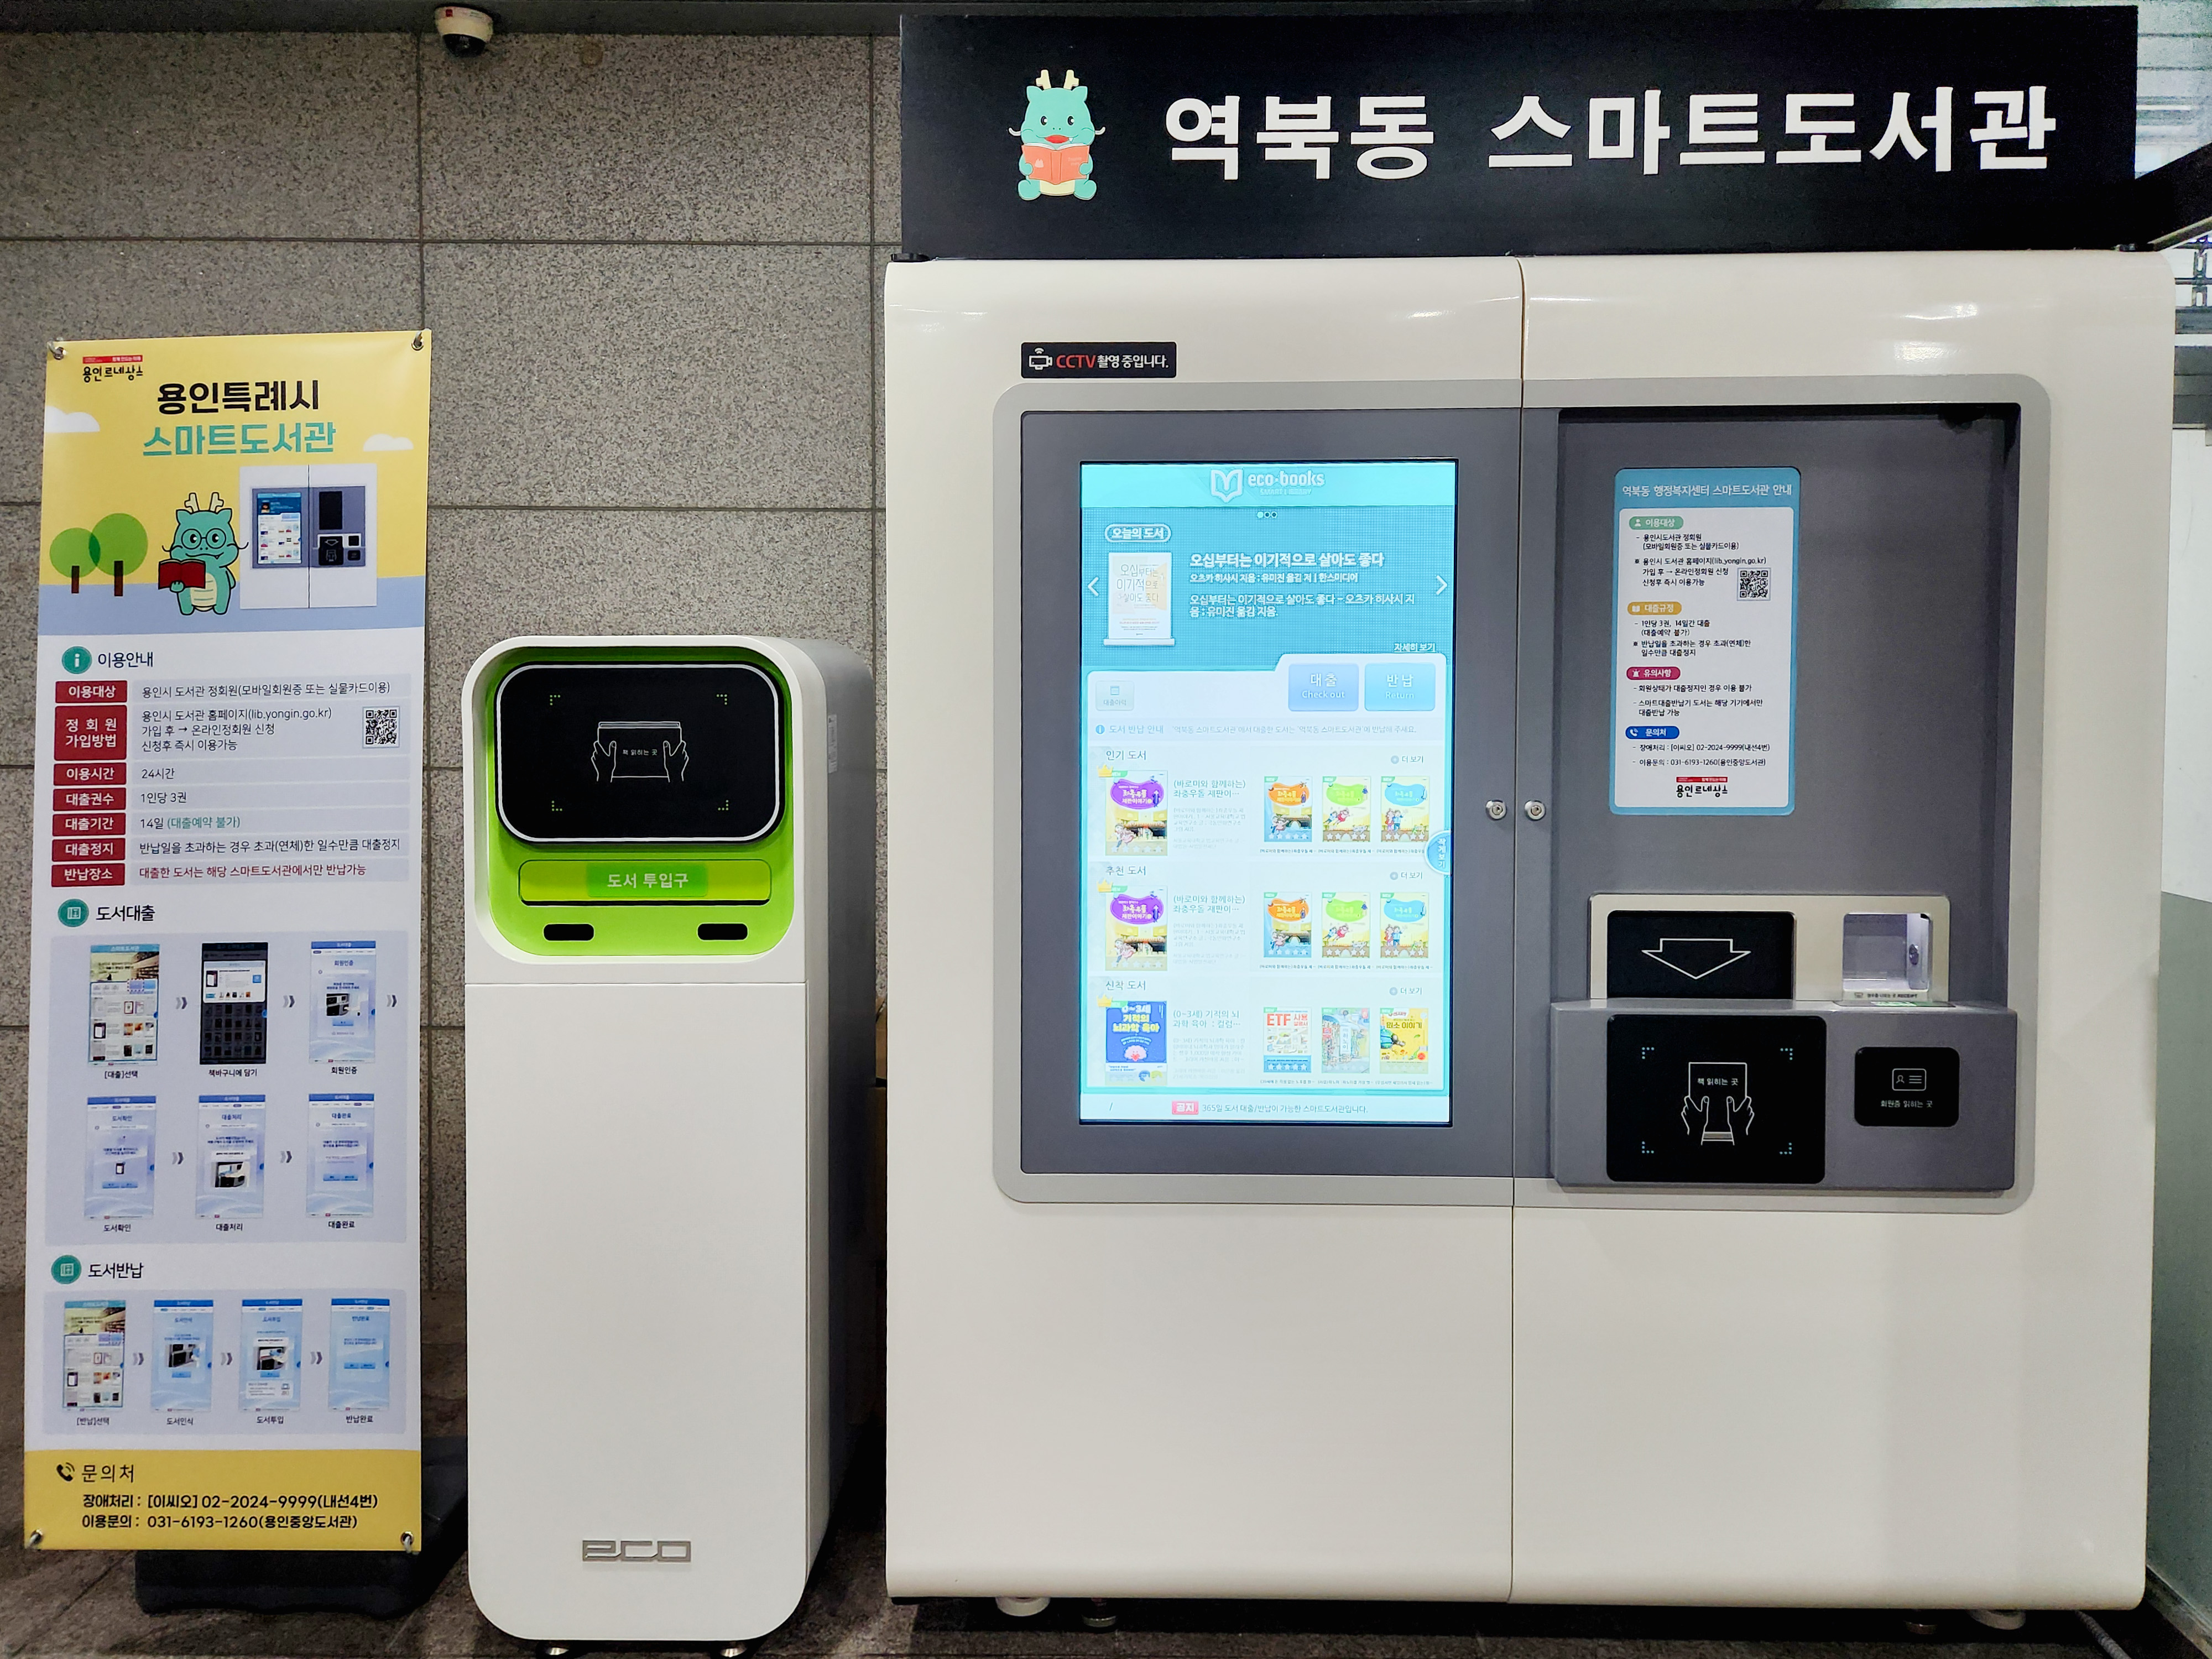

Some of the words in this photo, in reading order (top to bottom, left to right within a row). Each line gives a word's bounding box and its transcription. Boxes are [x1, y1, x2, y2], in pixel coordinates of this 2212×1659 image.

[1166, 96, 1433, 180] 역북동
[1489, 86, 2056, 175] 스마트도서관
[158, 380, 318, 414] 용인특례시
[143, 422, 336, 456] 스마트도서관
[1622, 486, 1650, 497] 역북동
[1654, 485, 1709, 497] 행정복지센터
[1713, 484, 1769, 497] 스마트도서관
[1773, 484, 1791, 495] 안내
[1645, 518, 1675, 528] 이용대상
[1111, 528, 1141, 539] 오늘의
[1144, 528, 1164, 539] 도서
[1644, 541, 1683, 550] (모바일회원증
[1190, 552, 1252, 568] 오십부터는
[1255, 553, 1316, 567] 이기적으로
[1319, 552, 1356, 567] 살아도
[1359, 552, 1385, 567] 좋다
[1686, 557, 1766, 565] 홈페이지(lib.yongin.go.kr)
[1643, 603, 1673, 613] 대출규정
[1394, 643, 1417, 651] 자세히
[1420, 643, 1436, 651] 보기
[98, 652, 153, 668] 이용안내
[1644, 669, 1671, 677] 유의사항
[69, 685, 116, 698] 이용대상
[142, 687, 171, 698] 용인시
[175, 686, 205, 697] 도서관
[208, 684, 302, 697] 정회원(모바일회원증
[305, 684, 325, 695] 또는
[328, 682, 389, 695] 실물카드이용)
[1302, 690, 1328, 698] Check
[142, 711, 171, 722] 용인시
[175, 710, 205, 721] 도서관
[208, 707, 331, 721] 홈페이지(lib.yongin.go.kr)
[142, 726, 161, 737] 가입
[165, 726, 175, 737] 후
[191, 724, 251, 735] 온라인정회원
[255, 723, 274, 734] 신청
[1109, 726, 1125, 734] 도서
[1129, 725, 1145, 734] 반납
[1147, 725, 1163, 734] 안내
[1646, 728, 1666, 737] 문의처
[66, 734, 116, 748] 가입방법
[142, 740, 171, 752] 신청후
[175, 740, 194, 751] 즉시
[198, 739, 237, 751] 이용가능
[1107, 750, 1124, 760] 인기
[1128, 750, 1146, 760] 도서
[67, 768, 114, 780] 이용시간
[142, 768, 175, 779] 24시간
[66, 792, 114, 806] 대출권수
[141, 792, 167, 804] 1인당
[170, 792, 186, 803] 3권
[65, 817, 114, 830] 대출기간
[140, 817, 163, 830] 14일
[168, 817, 212, 829] (대출예약
[216, 816, 240, 828] 불가)
[65, 843, 113, 855] 대출정지
[140, 842, 181, 854] 반납일을
[185, 842, 226, 853] 초과하는
[230, 841, 251, 853] 경우
[254, 840, 314, 852] 초과(연체)한
[318, 839, 359, 851] 일수만큼
[362, 838, 399, 851] 대출정지
[65, 868, 112, 881] 반납장소
[139, 867, 170, 879] 대출한
[173, 867, 204, 878] 도서는
[207, 866, 227, 878] 해당
[230, 864, 323, 877] 스마트도서관에서만
[327, 864, 366, 875] 반납가능
[1106, 866, 1124, 875] 추천
[1128, 866, 1146, 875] 도서
[607, 873, 637, 889] 도서
[643, 873, 689, 889] 투입구
[96, 905, 155, 921] 도서대출
[1106, 980, 1123, 990] 신착
[1127, 980, 1145, 990] 도서
[1267, 1014, 1291, 1025] ETF
[105, 1071, 138, 1079] [대출]선택
[1240, 1104, 1278, 1113] 대출/반납이
[88, 1262, 144, 1279] 도서반납
[77, 1417, 109, 1426] [반납]선택
[166, 1417, 193, 1426] 도서인식
[346, 1415, 373, 1423] 반납완료
[84, 1494, 133, 1507] 장애처리
[148, 1495, 197, 1508] [이씨오]
[202, 1495, 377, 1509] 02-2024-9999(내선4번)
[82, 1515, 132, 1528] 이용문의
[148, 1516, 357, 1528] 031-6193-1260(용인중앙도서관)
